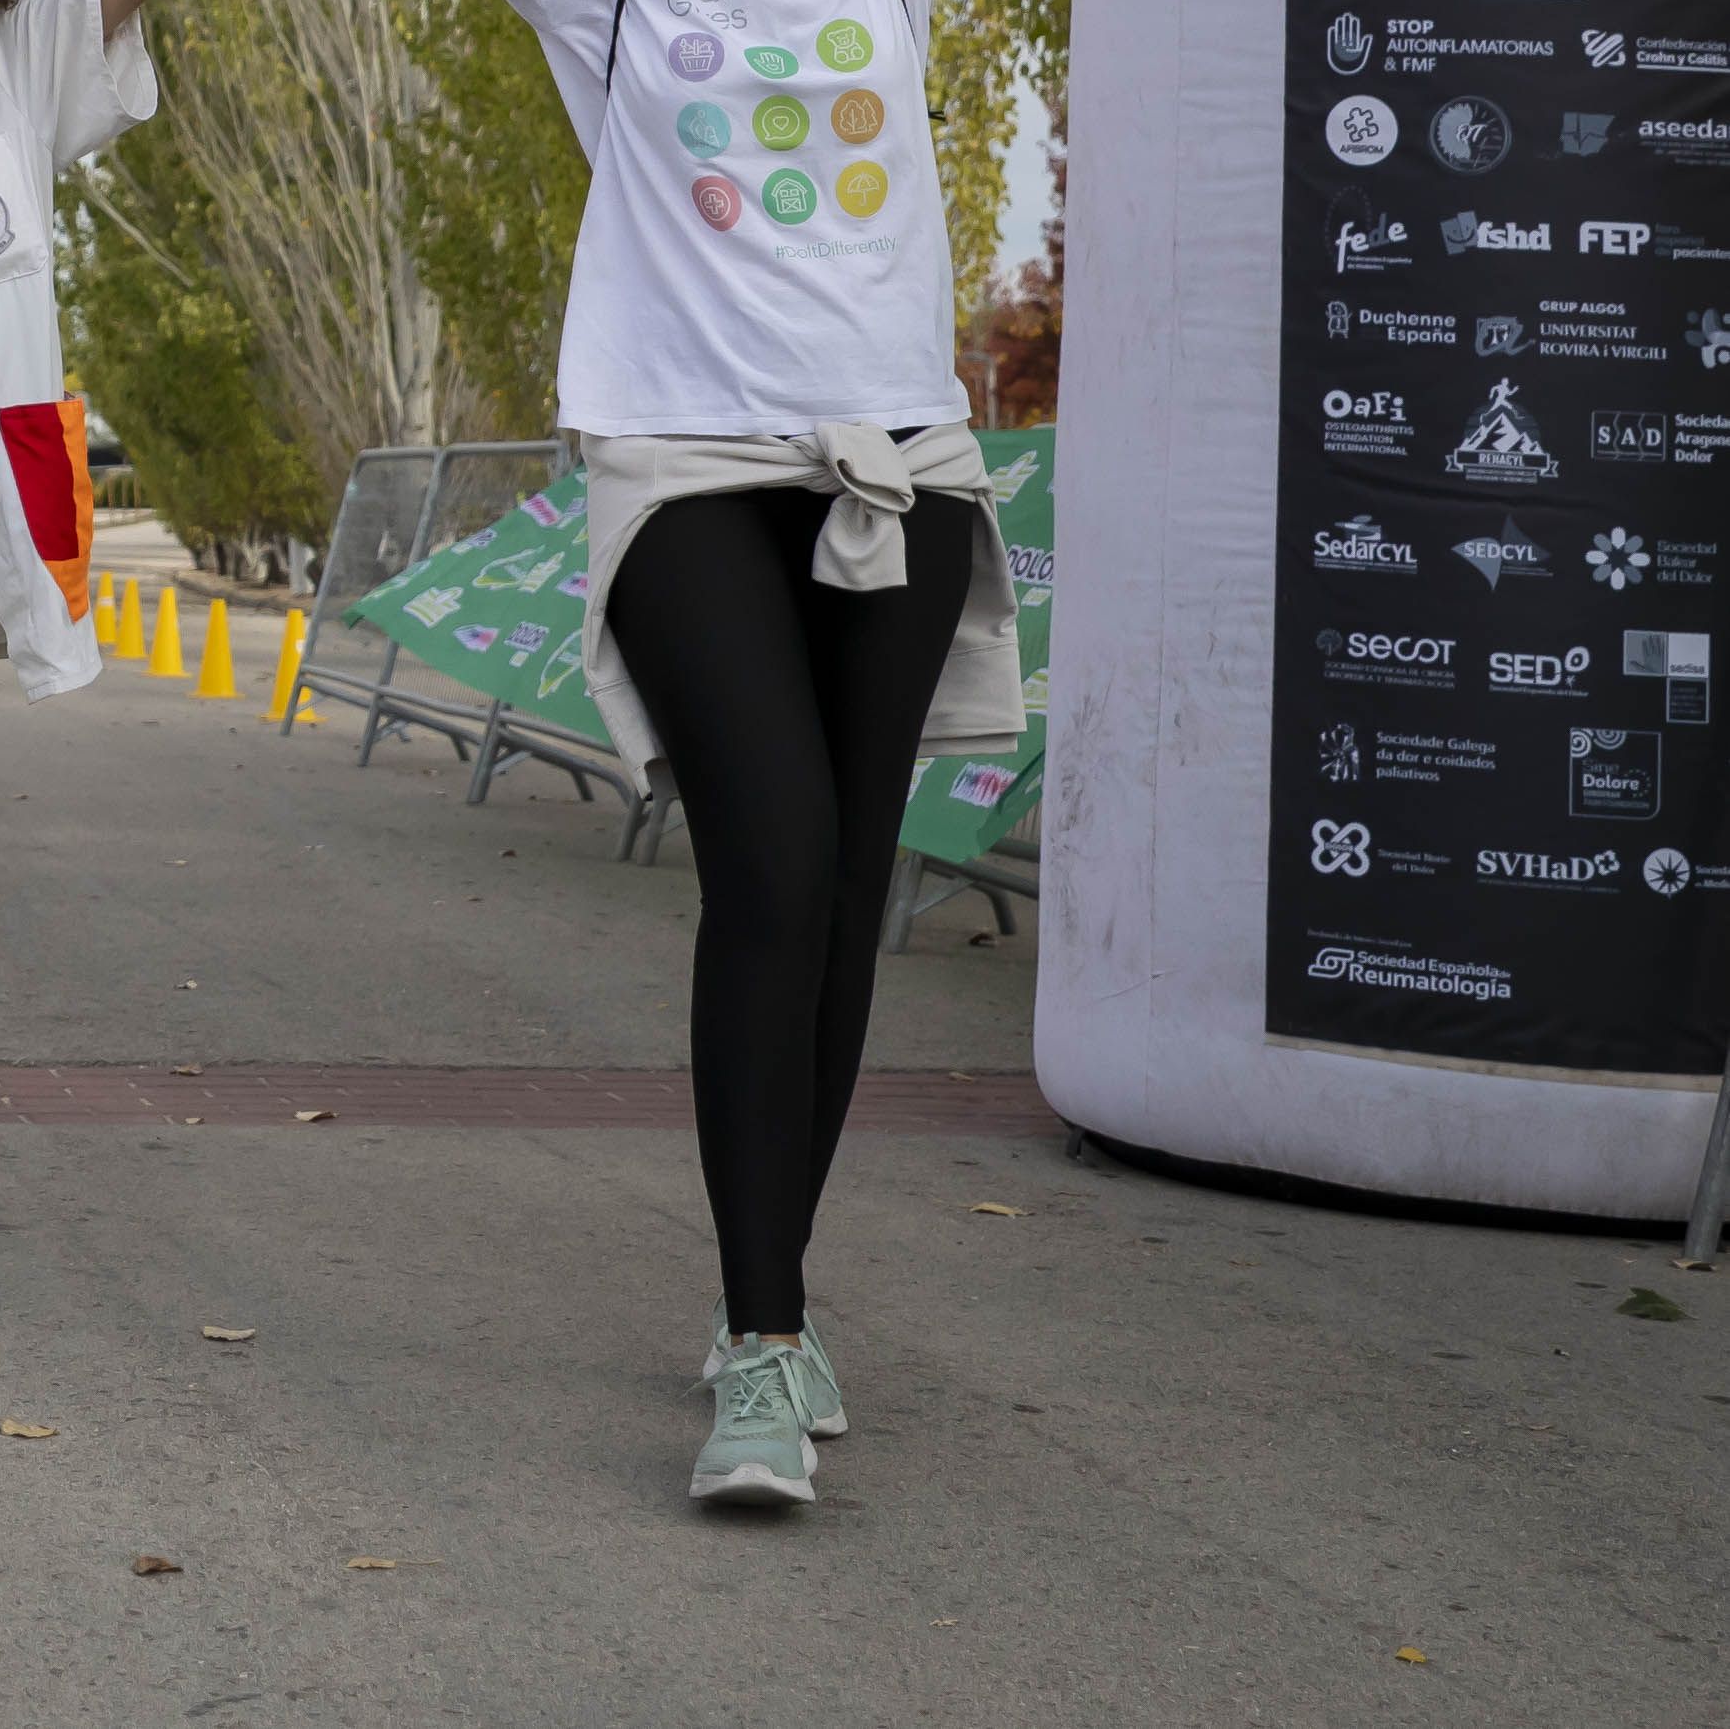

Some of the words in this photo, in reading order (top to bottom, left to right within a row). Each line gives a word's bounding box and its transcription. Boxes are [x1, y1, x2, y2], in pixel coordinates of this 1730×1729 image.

[1387, 20, 1434, 34] STOP
[1387, 38, 1554, 56] AUTOINFLAMATORIAS
[1636, 50, 1675, 63] Crohn
[1403, 57, 1436, 71] FMF
[1639, 118, 1730, 139] aseeda
[1477, 221, 1552, 252] fshd
[1579, 221, 1651, 256] FEP
[1539, 300, 1578, 312] GRUP
[1580, 302, 1626, 315] ALGOS
[1359, 309, 1456, 328] Duchenne
[1388, 326, 1457, 345] España
[1540, 322, 1638, 339] UNIVERSITAT
[1540, 342, 1599, 357] ROVIRA
[1611, 346, 1667, 360] VIRGILI
[1675, 449, 1714, 463] Dolor
[1314, 531, 1418, 563] SedarCYL
[1463, 541, 1537, 562] SEDCYL
[1376, 732, 1444, 748] Sociedade
[1448, 738, 1496, 755] Galega
[1376, 748, 1393, 760] da
[1397, 750, 1418, 763] dor
[1423, 755, 1431, 764] e
[1435, 754, 1496, 770] coidados
[1376, 766, 1440, 782] paliativos
[1582, 773, 1640, 791] Dolore
[1476, 850, 1595, 881] SVHaD
[1357, 950, 1426, 970] Sociedad
[1428, 958, 1500, 978] Española
[1349, 962, 1511, 1001] Reumatología
